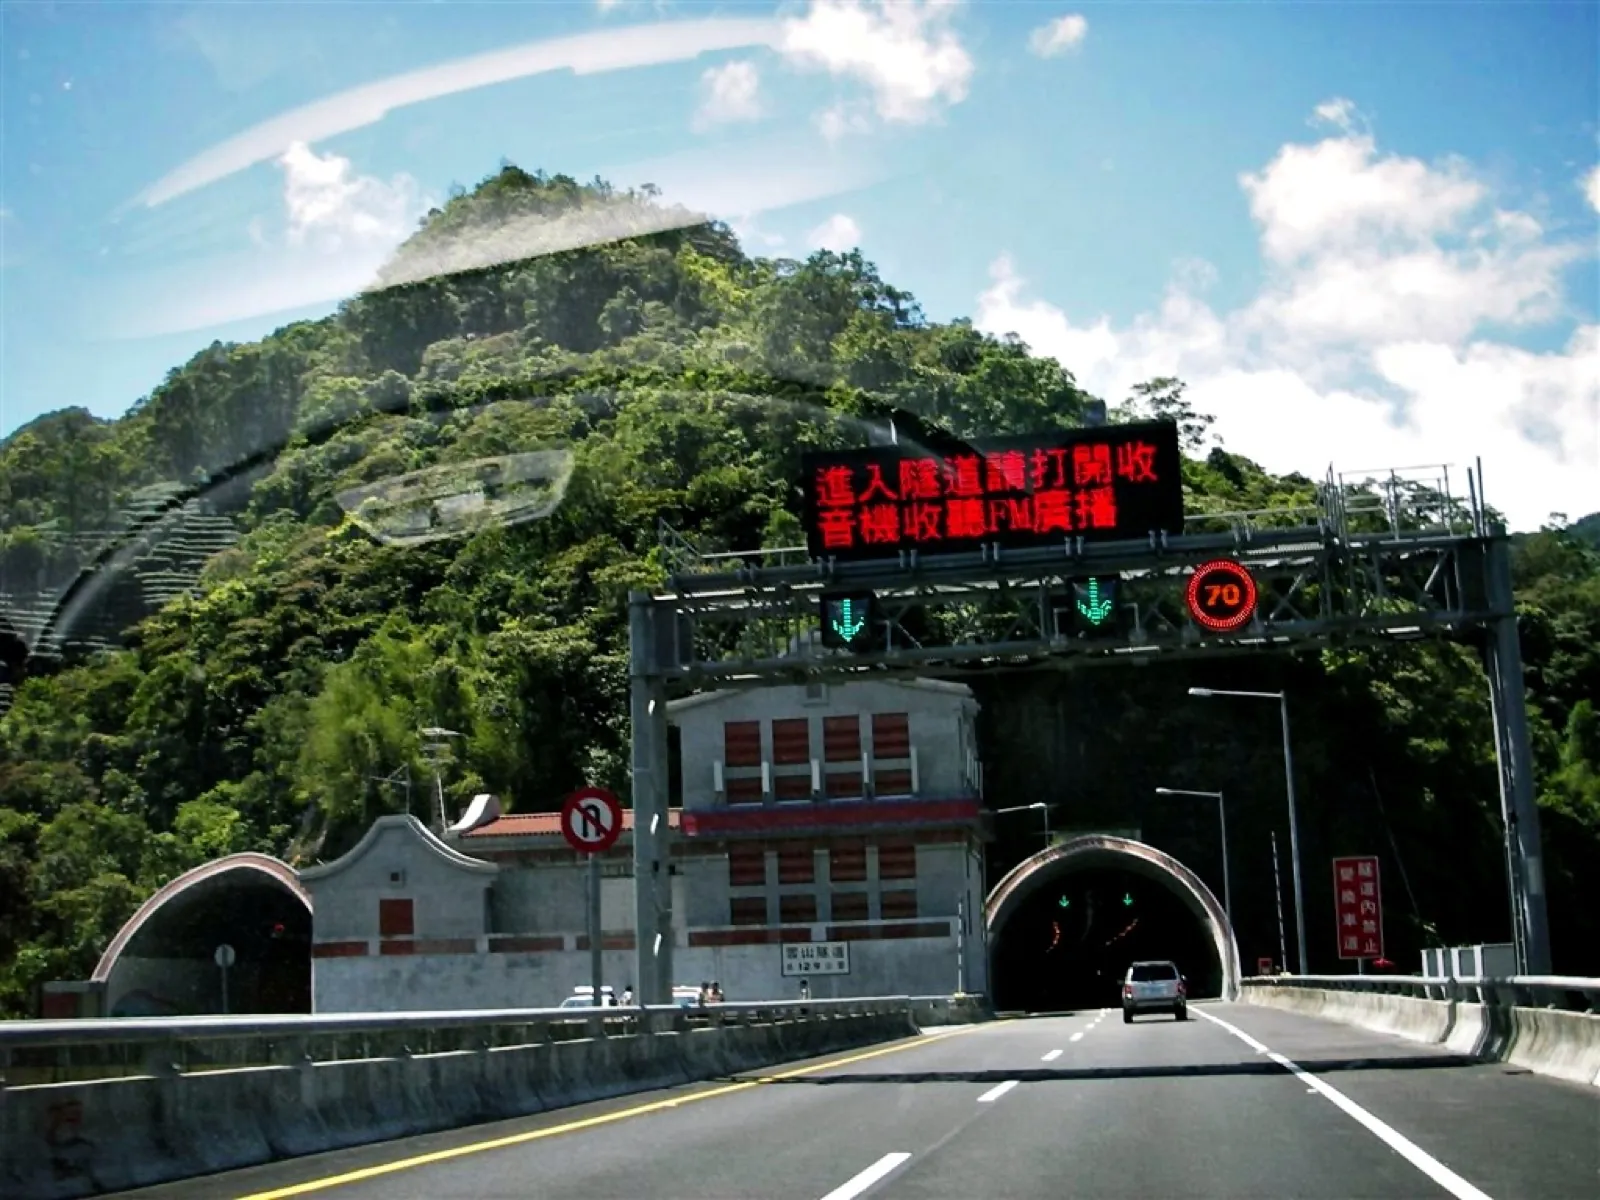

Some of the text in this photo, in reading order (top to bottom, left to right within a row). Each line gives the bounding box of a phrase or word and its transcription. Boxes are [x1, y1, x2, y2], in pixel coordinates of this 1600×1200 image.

[816, 441, 1158, 507] 進入隧道請打開收
[1204, 584, 1240, 606] 70
